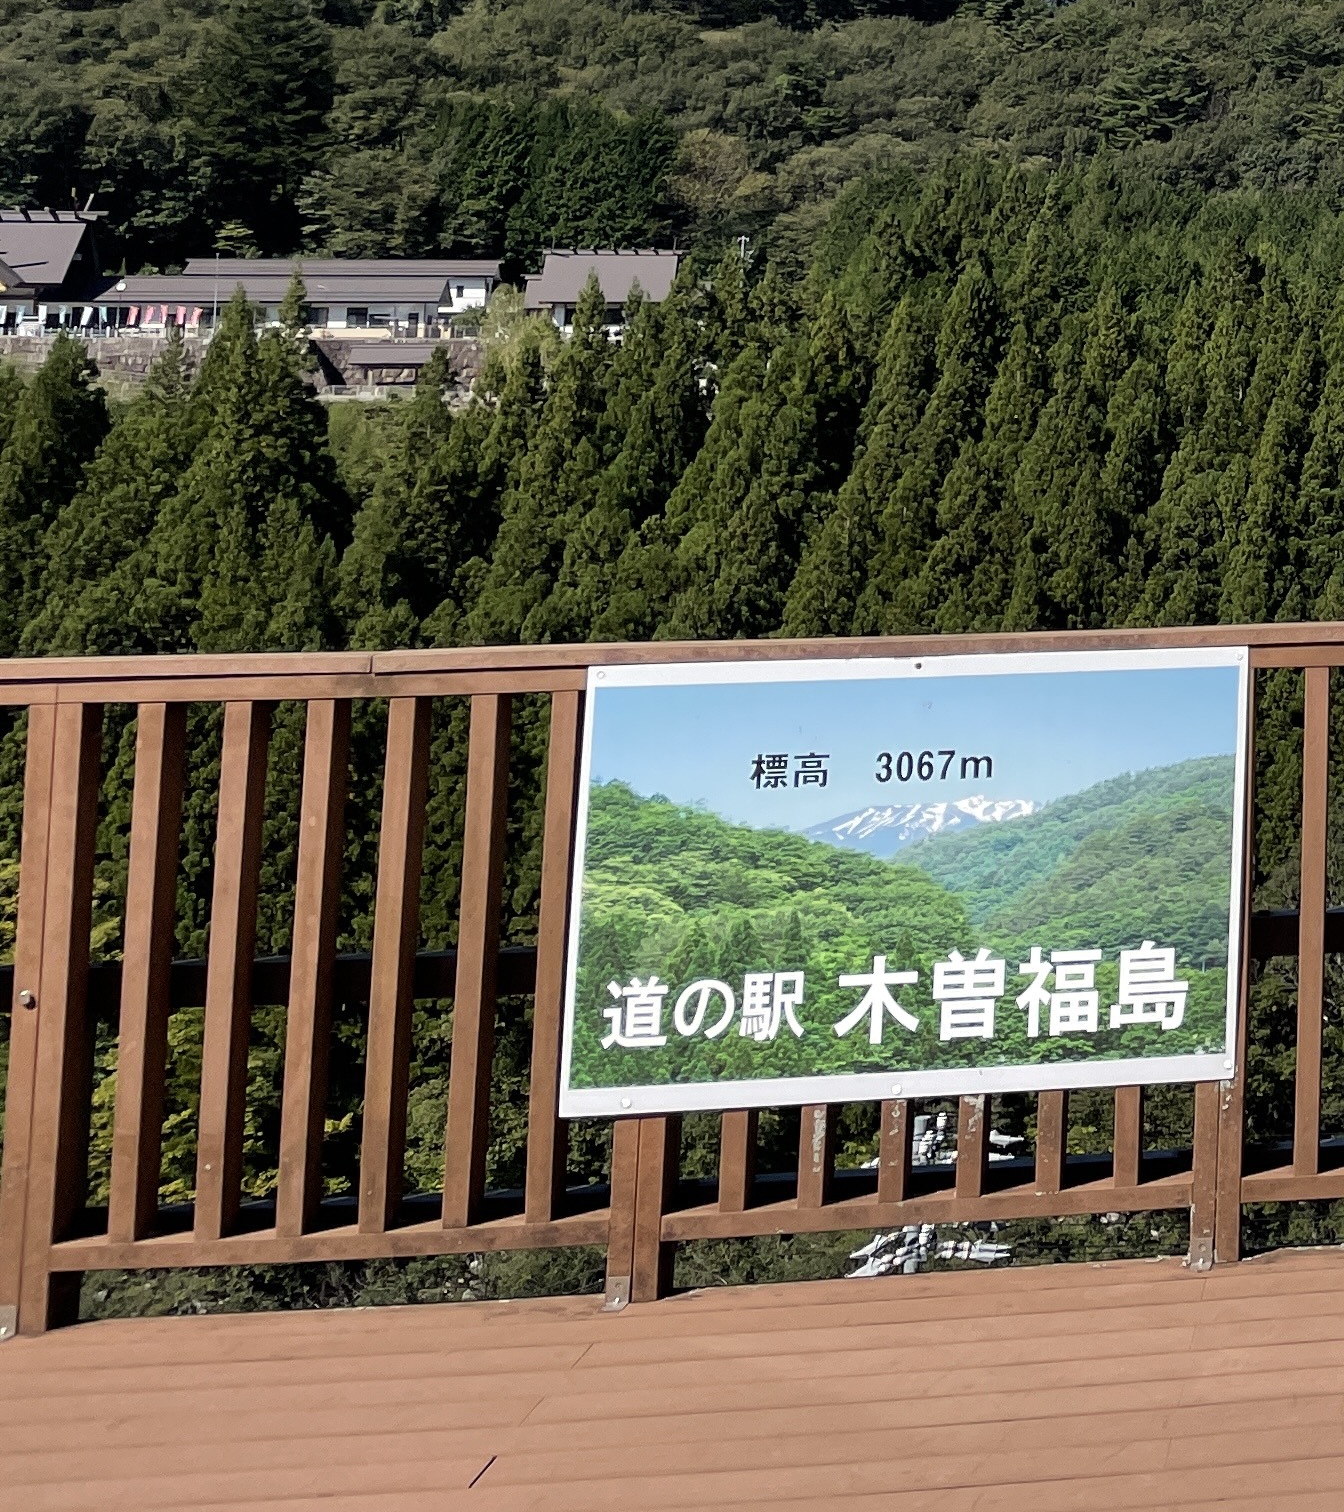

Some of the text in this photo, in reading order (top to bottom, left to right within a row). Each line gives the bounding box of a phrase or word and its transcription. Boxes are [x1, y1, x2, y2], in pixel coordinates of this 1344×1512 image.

[749, 749, 994, 790] 標高 3067m
[600, 939, 1189, 1050] 道の駅 木曽福島
